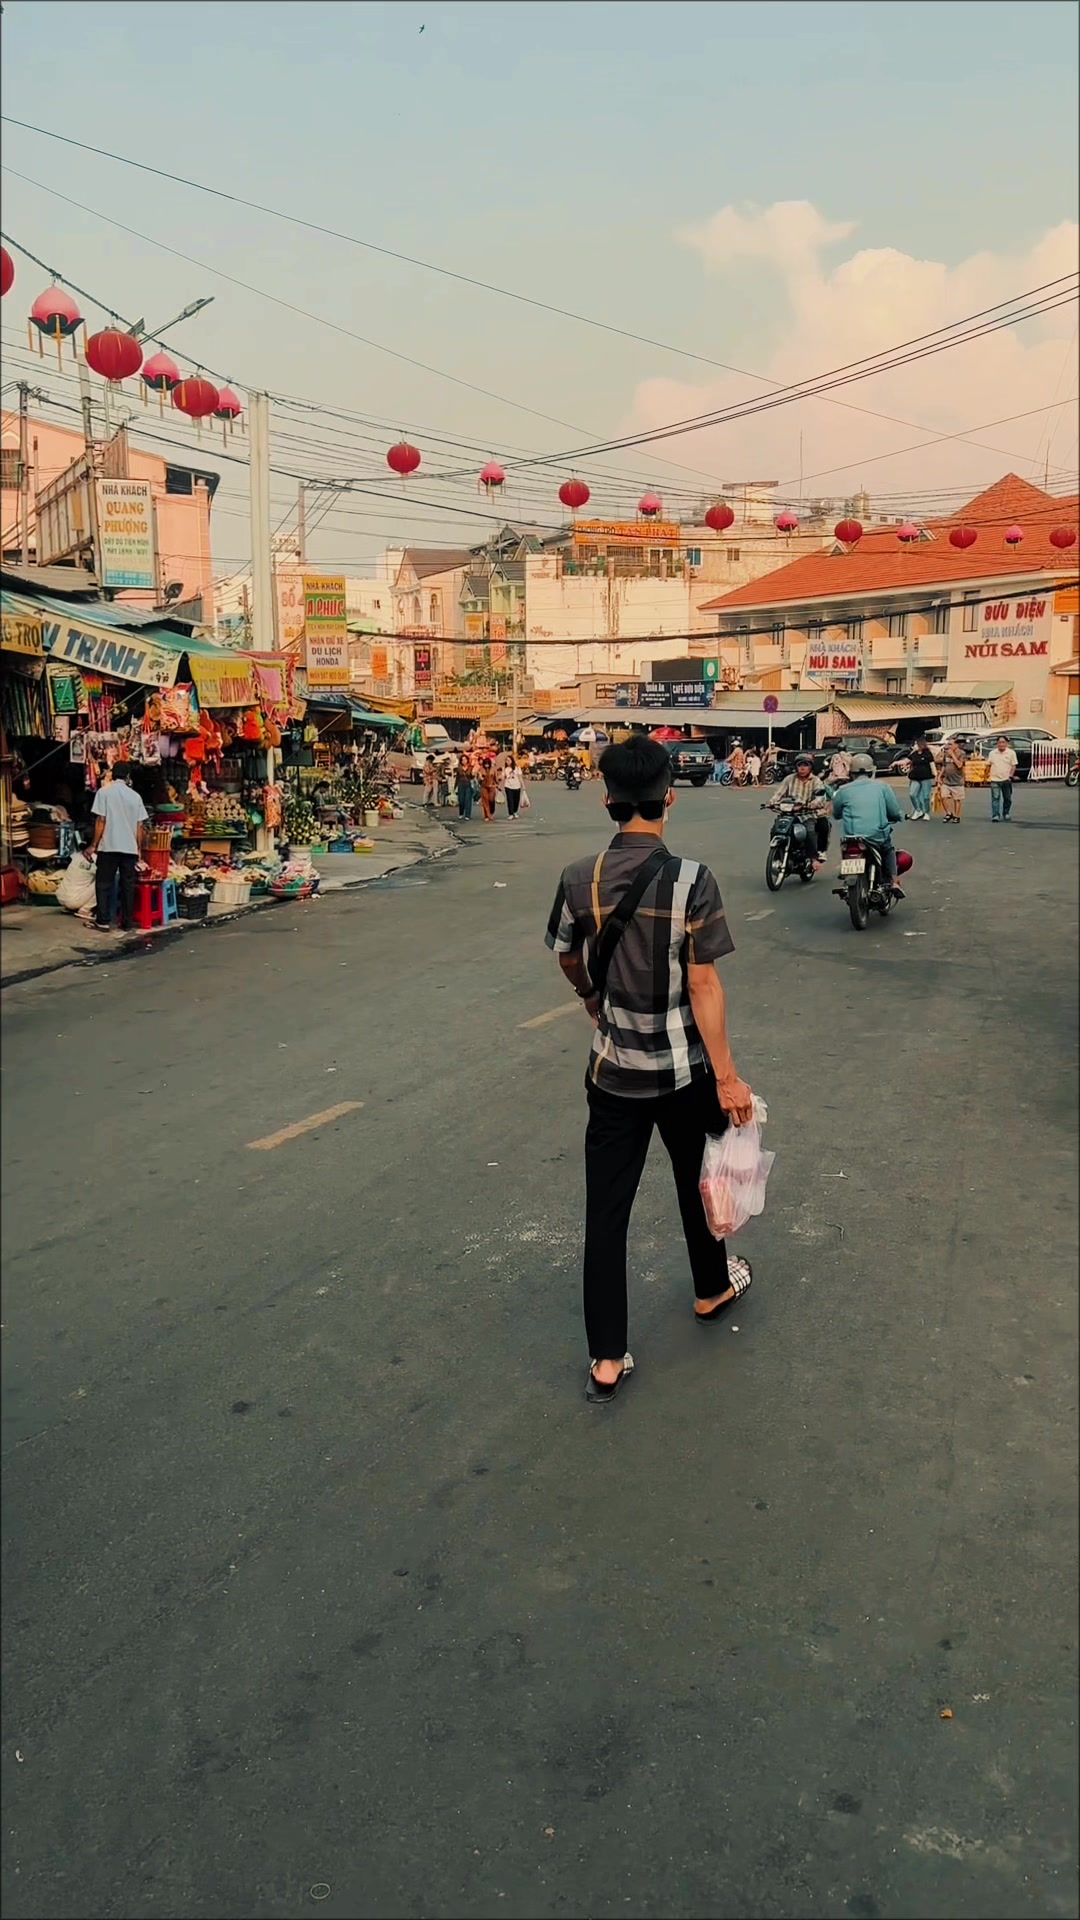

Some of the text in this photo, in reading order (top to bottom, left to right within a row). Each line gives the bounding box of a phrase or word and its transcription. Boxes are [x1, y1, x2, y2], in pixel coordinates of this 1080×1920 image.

[106, 501, 145, 516] QUANG
[104, 518, 148, 535] PHƯỢNG
[63, 628, 147, 678] TRINH
[312, 648, 342, 657] DU LỊCH
[964, 639, 1048, 658] NÚI SAM
[316, 658, 339, 666] HONDA
[809, 652, 856, 669] NÚI SAM
